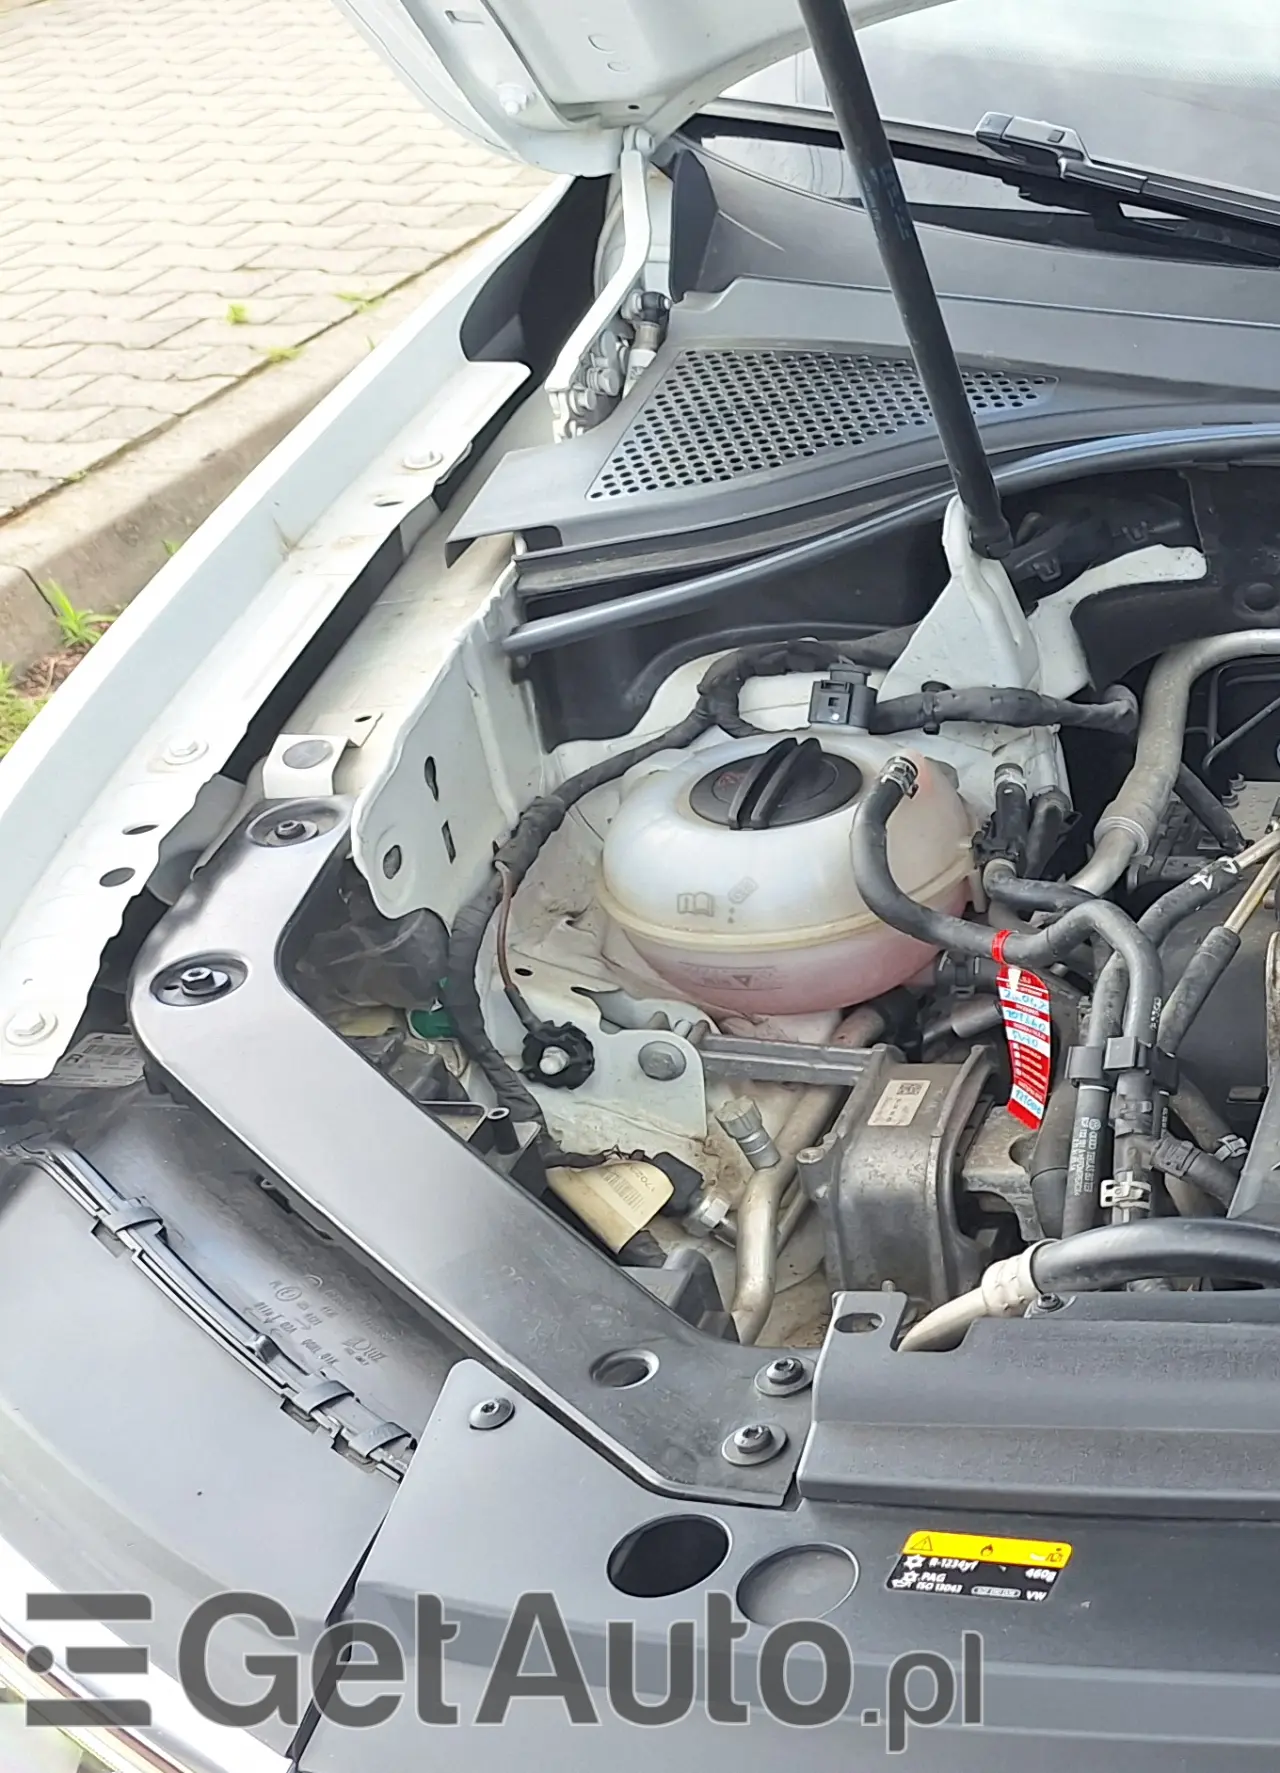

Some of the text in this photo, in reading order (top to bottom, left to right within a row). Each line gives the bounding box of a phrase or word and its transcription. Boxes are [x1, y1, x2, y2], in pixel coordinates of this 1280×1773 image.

[928, 1559, 1057, 1583] R-1234yf 460g
[921, 1572, 948, 1582] PAG
[916, 1582, 933, 1591] ISO
[934, 1583, 964, 1594] 13043
[1026, 1590, 1048, 1601] VW
